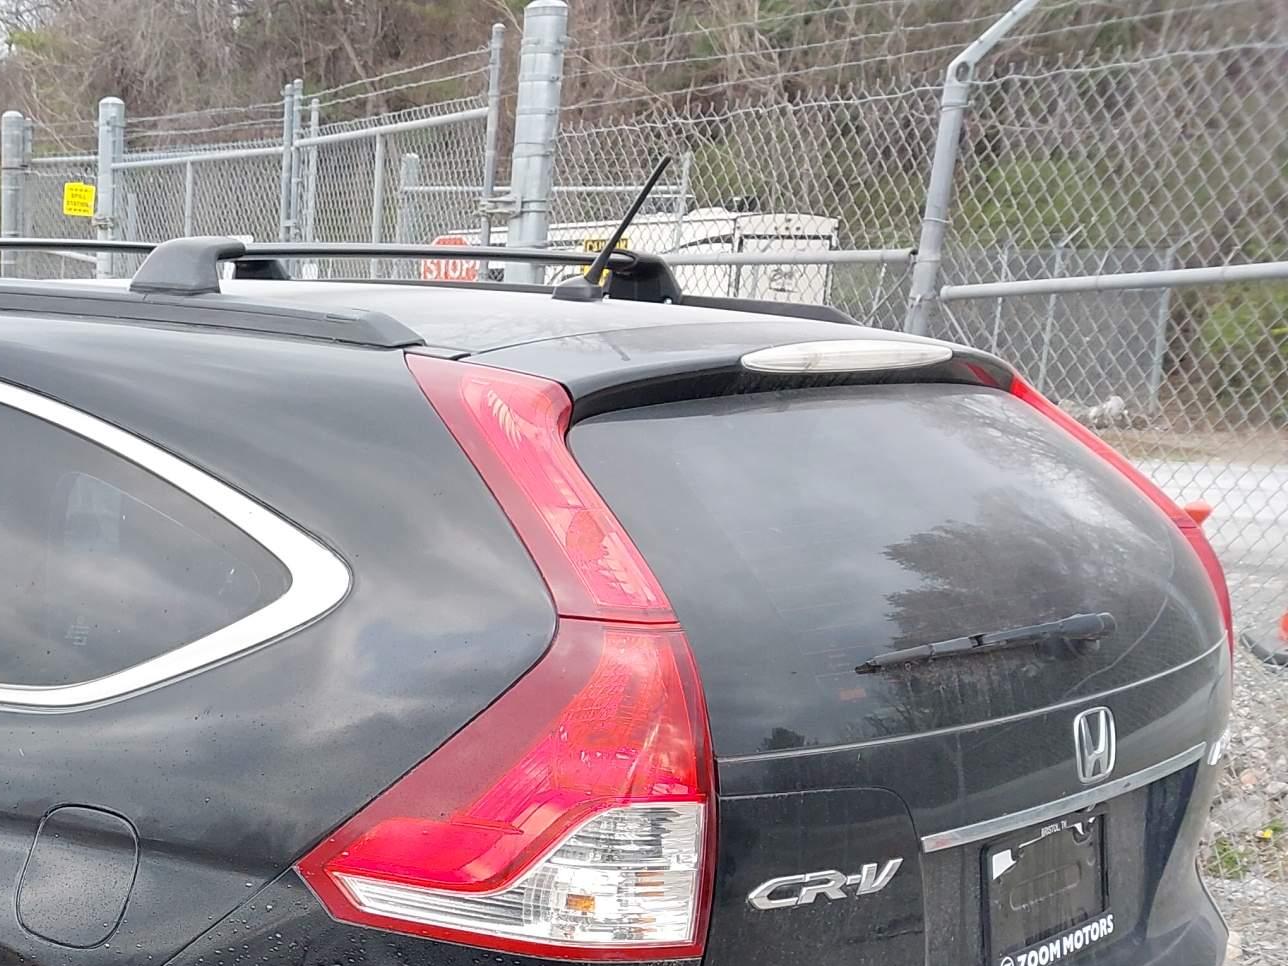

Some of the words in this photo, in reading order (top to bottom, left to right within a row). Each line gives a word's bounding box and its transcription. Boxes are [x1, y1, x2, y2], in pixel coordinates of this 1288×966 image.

[425, 257, 476, 279] STOP
[748, 858, 903, 910] CR-V
[1063, 914, 1114, 956] MOTORS
